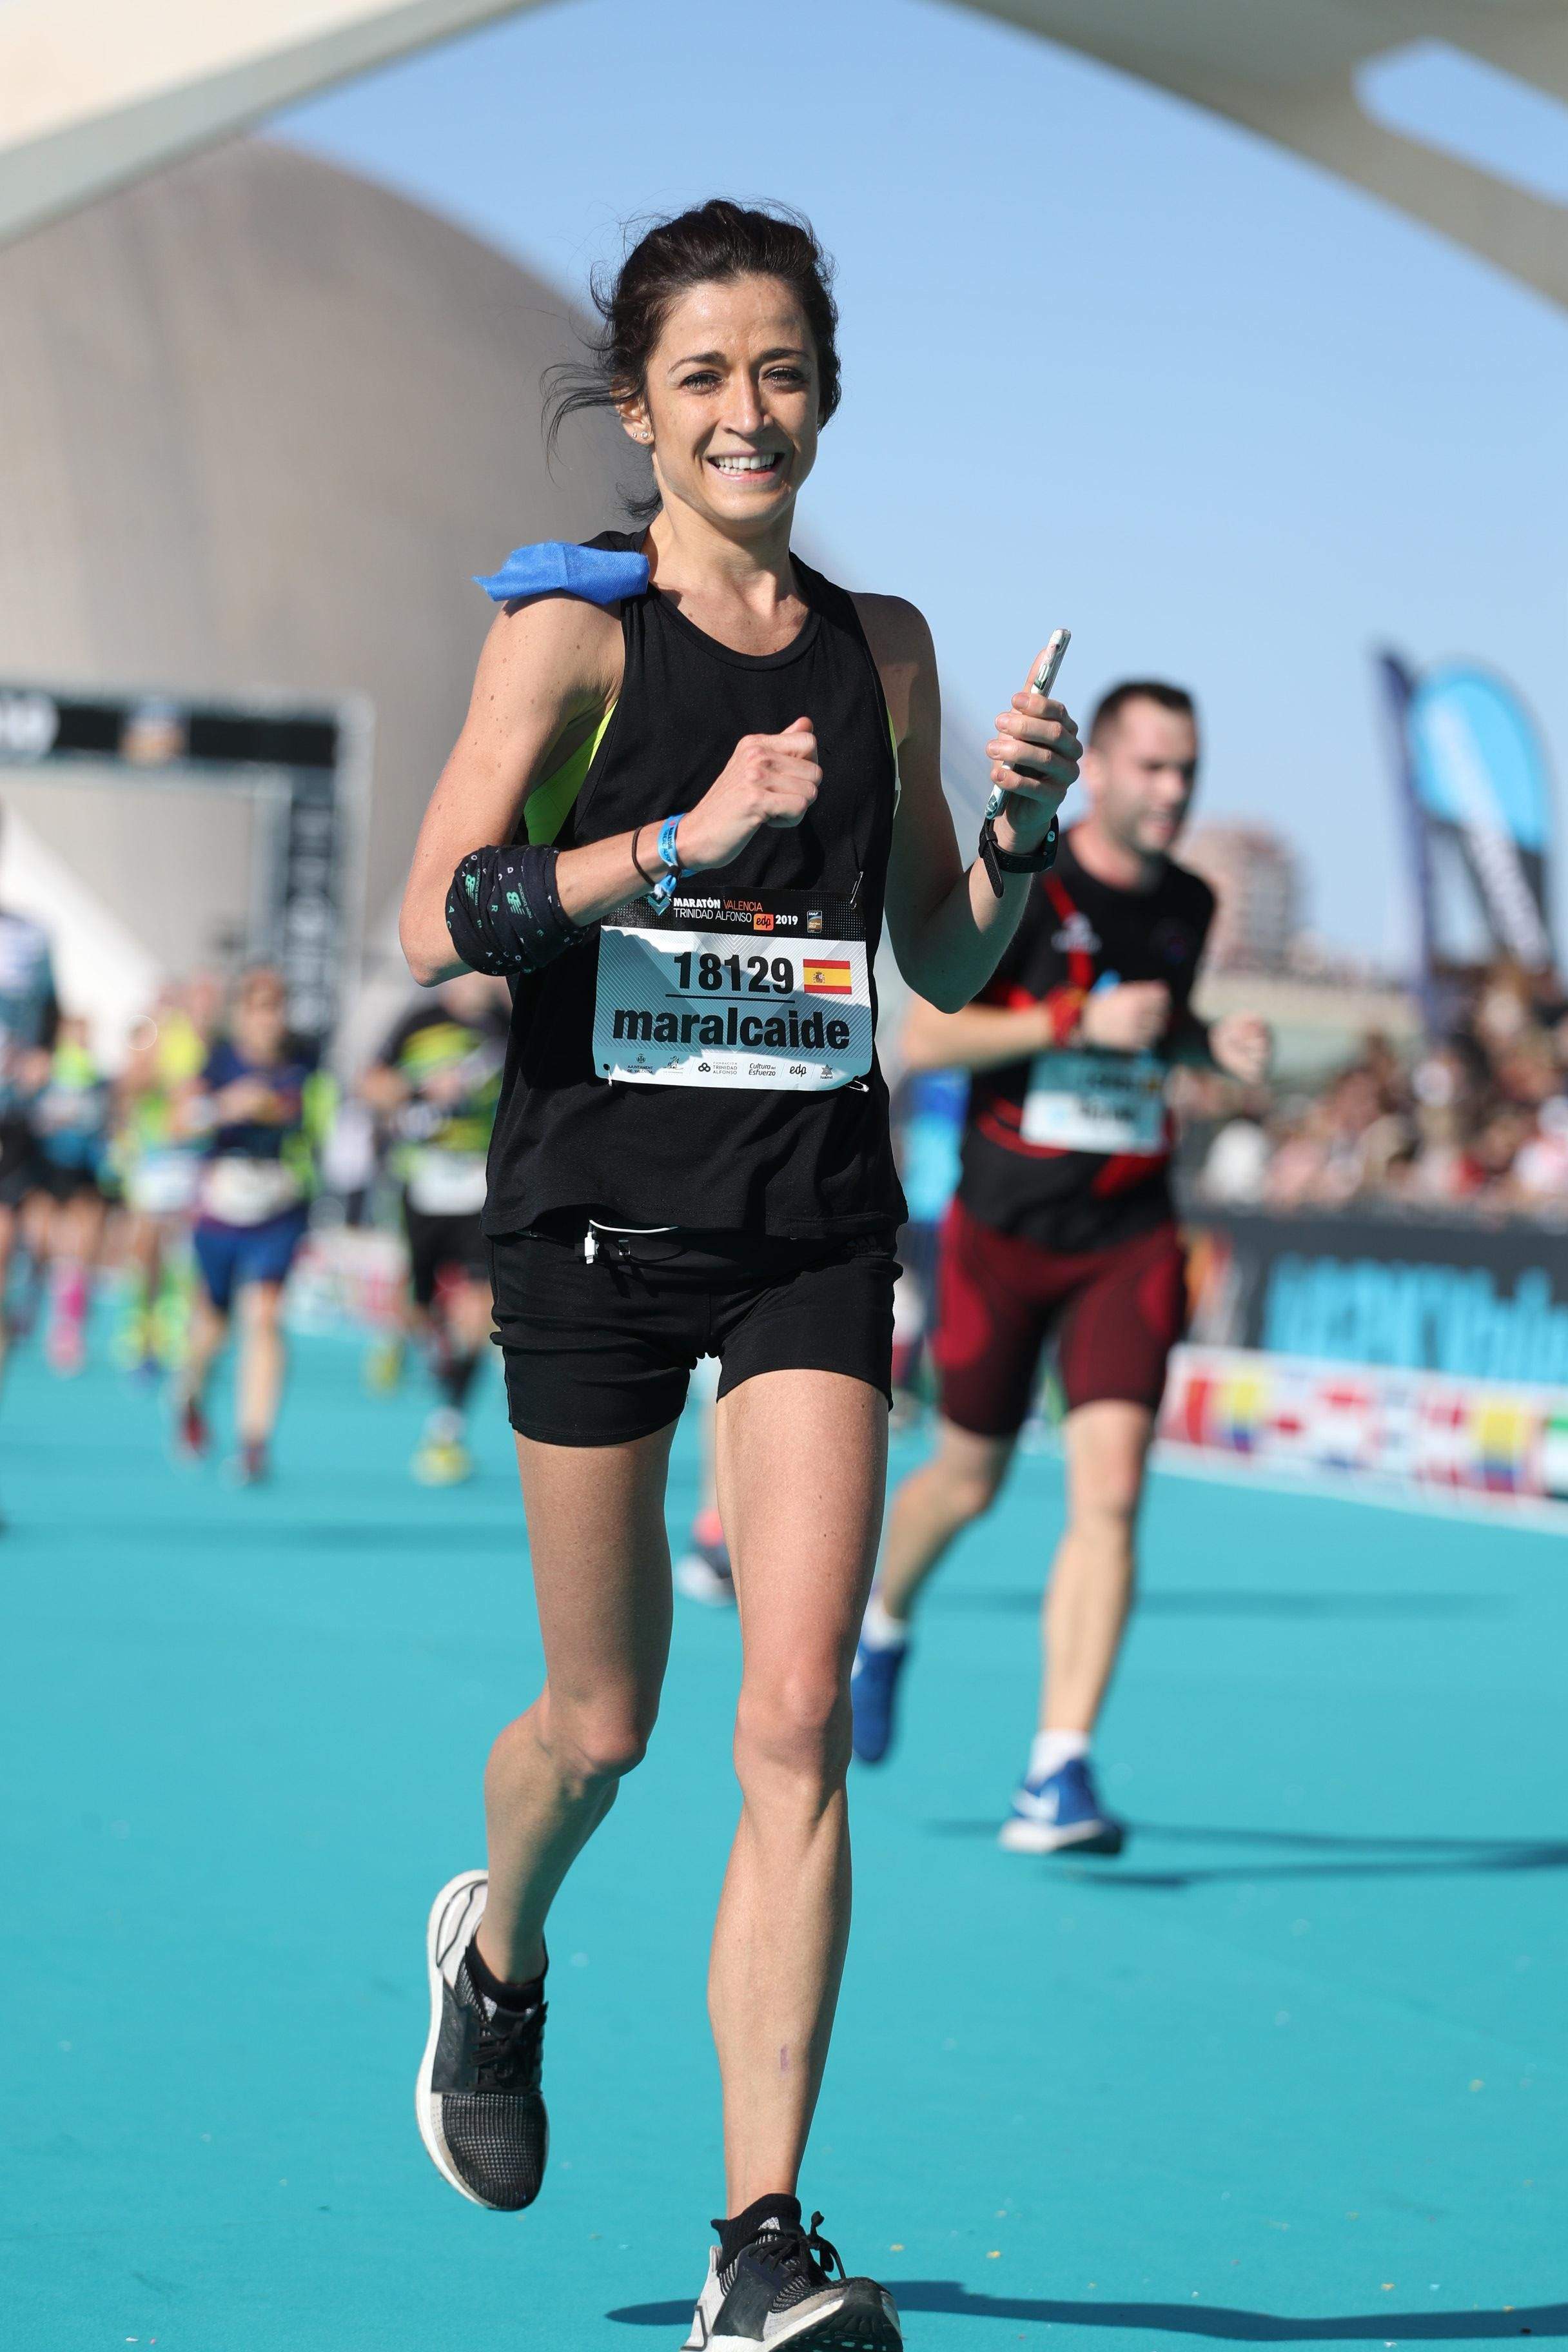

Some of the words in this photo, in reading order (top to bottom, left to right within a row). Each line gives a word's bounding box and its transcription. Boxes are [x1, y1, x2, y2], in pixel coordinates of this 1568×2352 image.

[673, 897, 721, 909] MARATÓN
[723, 899, 763, 912] VALENCIA
[673, 908, 714, 919] TRINIDAD
[715, 910, 752, 923] ALFONSO
[756, 916, 771, 928] edp
[775, 914, 798, 925] 2019
[674, 952, 794, 994] 18129
[612, 1007, 850, 1050] maralcaide
[789, 1063, 807, 1077] edp
